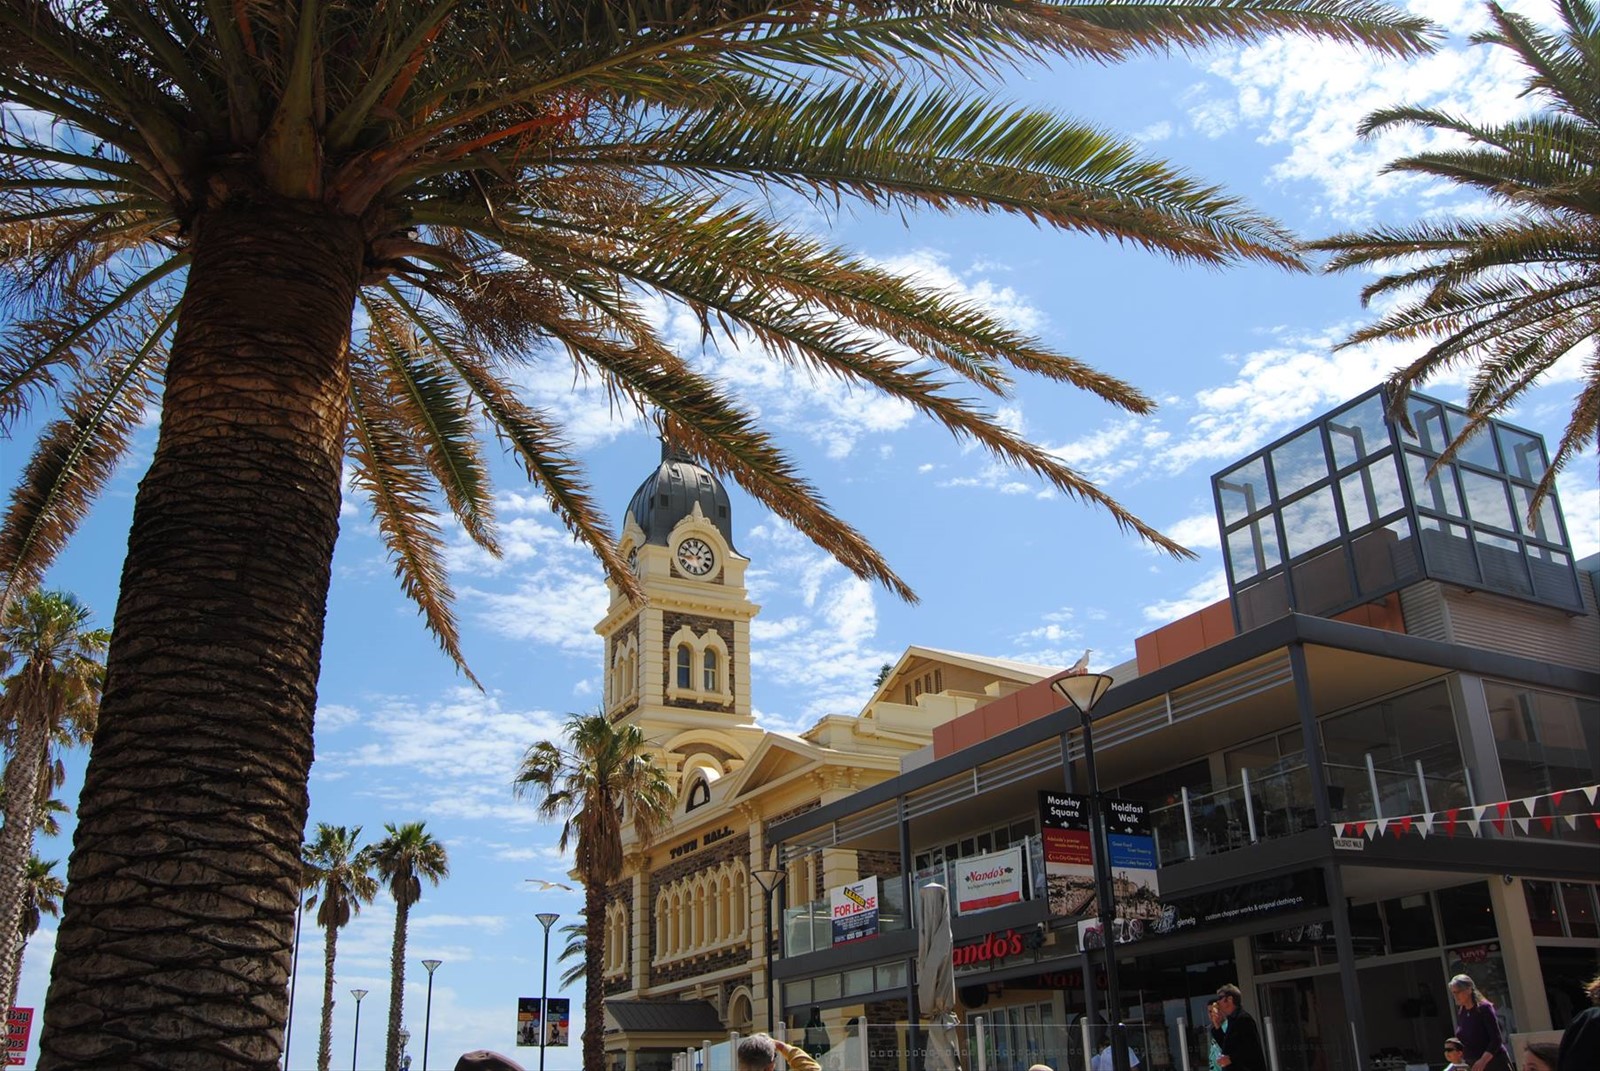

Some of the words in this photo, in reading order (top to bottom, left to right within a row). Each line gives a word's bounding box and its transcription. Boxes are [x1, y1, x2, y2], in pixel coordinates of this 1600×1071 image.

[1047, 795, 1081, 809] Moseley
[1111, 802, 1144, 813] Holdfast
[1050, 806, 1080, 818] Square
[1117, 813, 1139, 823] Walk
[669, 838, 698, 859] TOWN
[970, 866, 1004, 881] Nando's
[834, 903, 851, 918] FOR
[852, 896, 876, 913] LESE
[1205, 911, 1222, 921] custom
[1221, 908, 1240, 919] chopper
[1239, 905, 1254, 916] works
[1258, 900, 1276, 911] original
[1276, 896, 1297, 908] clothing
[953, 928, 1022, 966] ando's
